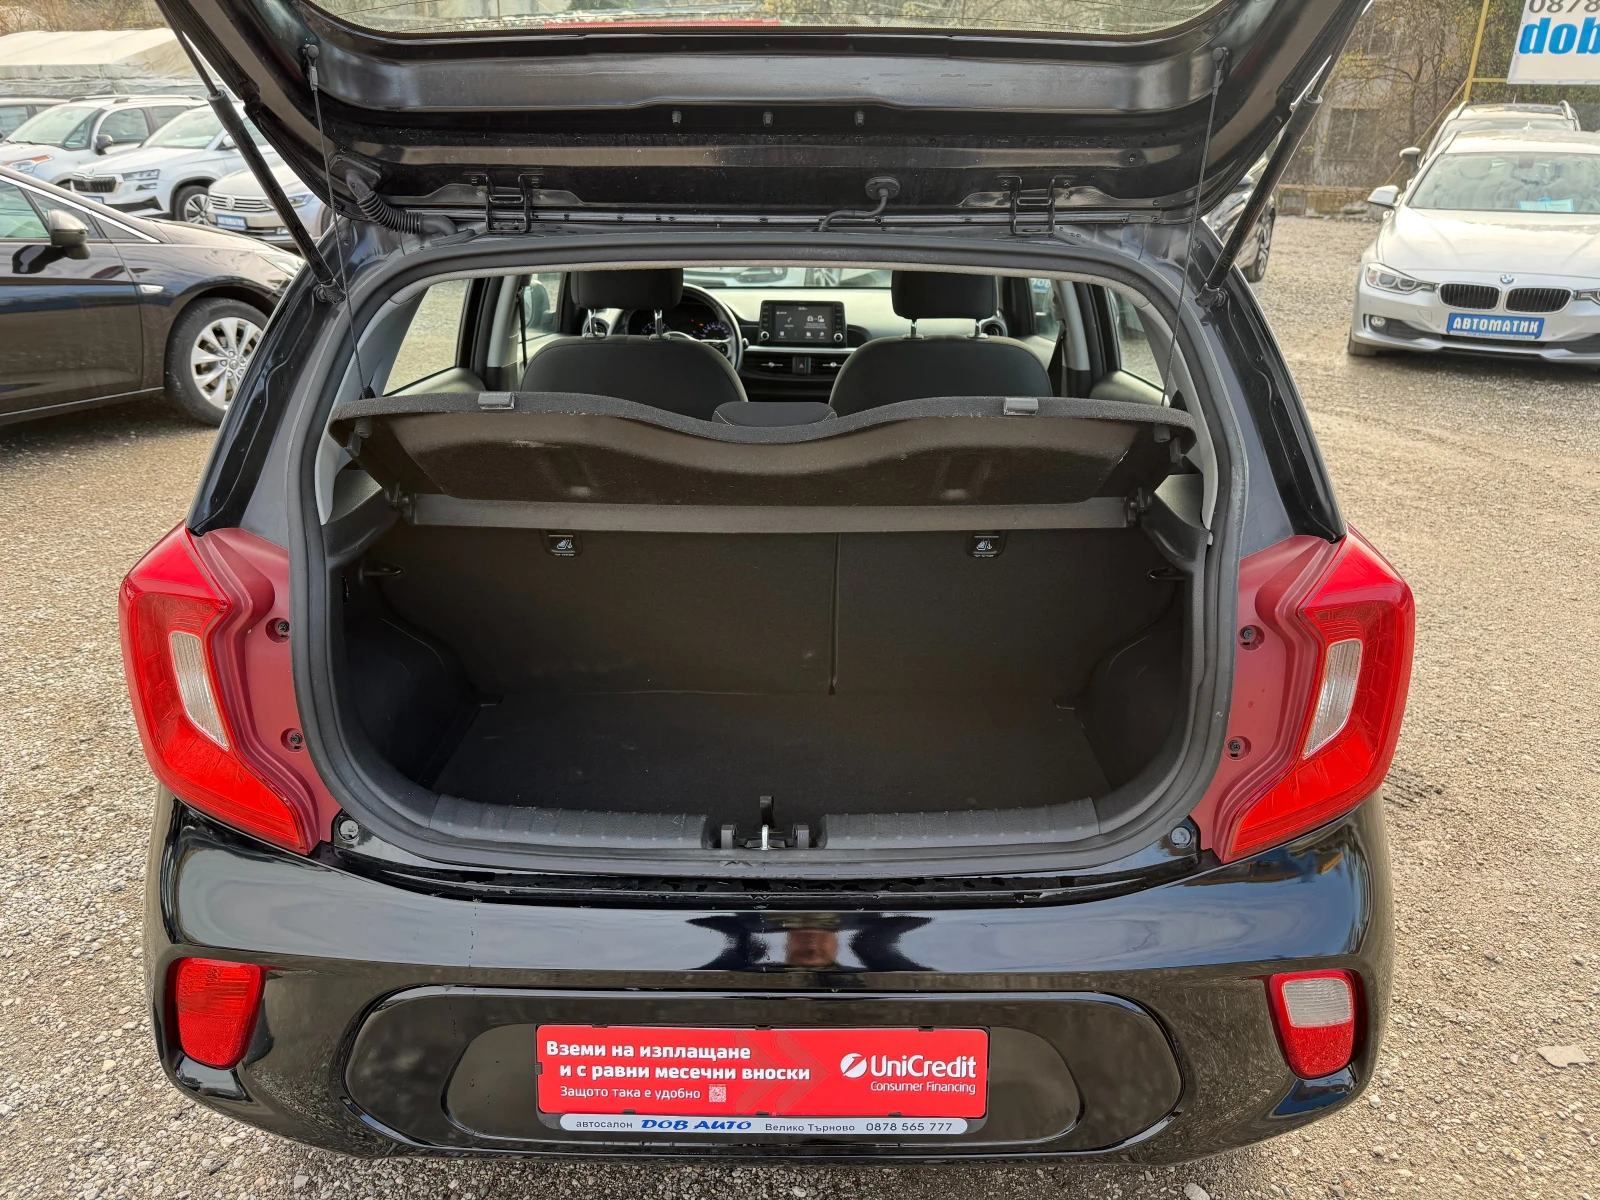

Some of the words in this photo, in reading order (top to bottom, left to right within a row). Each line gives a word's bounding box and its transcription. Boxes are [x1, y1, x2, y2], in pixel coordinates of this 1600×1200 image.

[1528, 0, 1600, 14] 0878
[1518, 16, 1600, 55] dob
[1452, 316, 1540, 334] АВТОМАТИК
[546, 1040, 607, 1056] Вземи
[611, 1045, 635, 1057] на
[639, 1046, 751, 1062] изплащане
[559, 1065, 572, 1077] и
[576, 1065, 587, 1078] с
[591, 1065, 650, 1081] равни
[655, 1067, 737, 1080] месечни
[741, 1068, 811, 1080] вноски
[870, 1054, 977, 1078] UniCredit
[560, 1086, 609, 1098] Защото
[612, 1088, 641, 1098] така
[644, 1089, 652, 1099] е
[655, 1088, 701, 1100] удобно
[870, 1081, 924, 1092] Consumer
[926, 1081, 976, 1096] Financing
[576, 1120, 633, 1129] автосалон
[641, 1119, 689, 1131] DOB
[693, 1120, 752, 1130] AUTO
[765, 1123, 805, 1131] Велико
[808, 1123, 855, 1133] Търново
[866, 1122, 898, 1131] 0878
[901, 1122, 925, 1131] 565
[929, 1122, 953, 1131] 777
